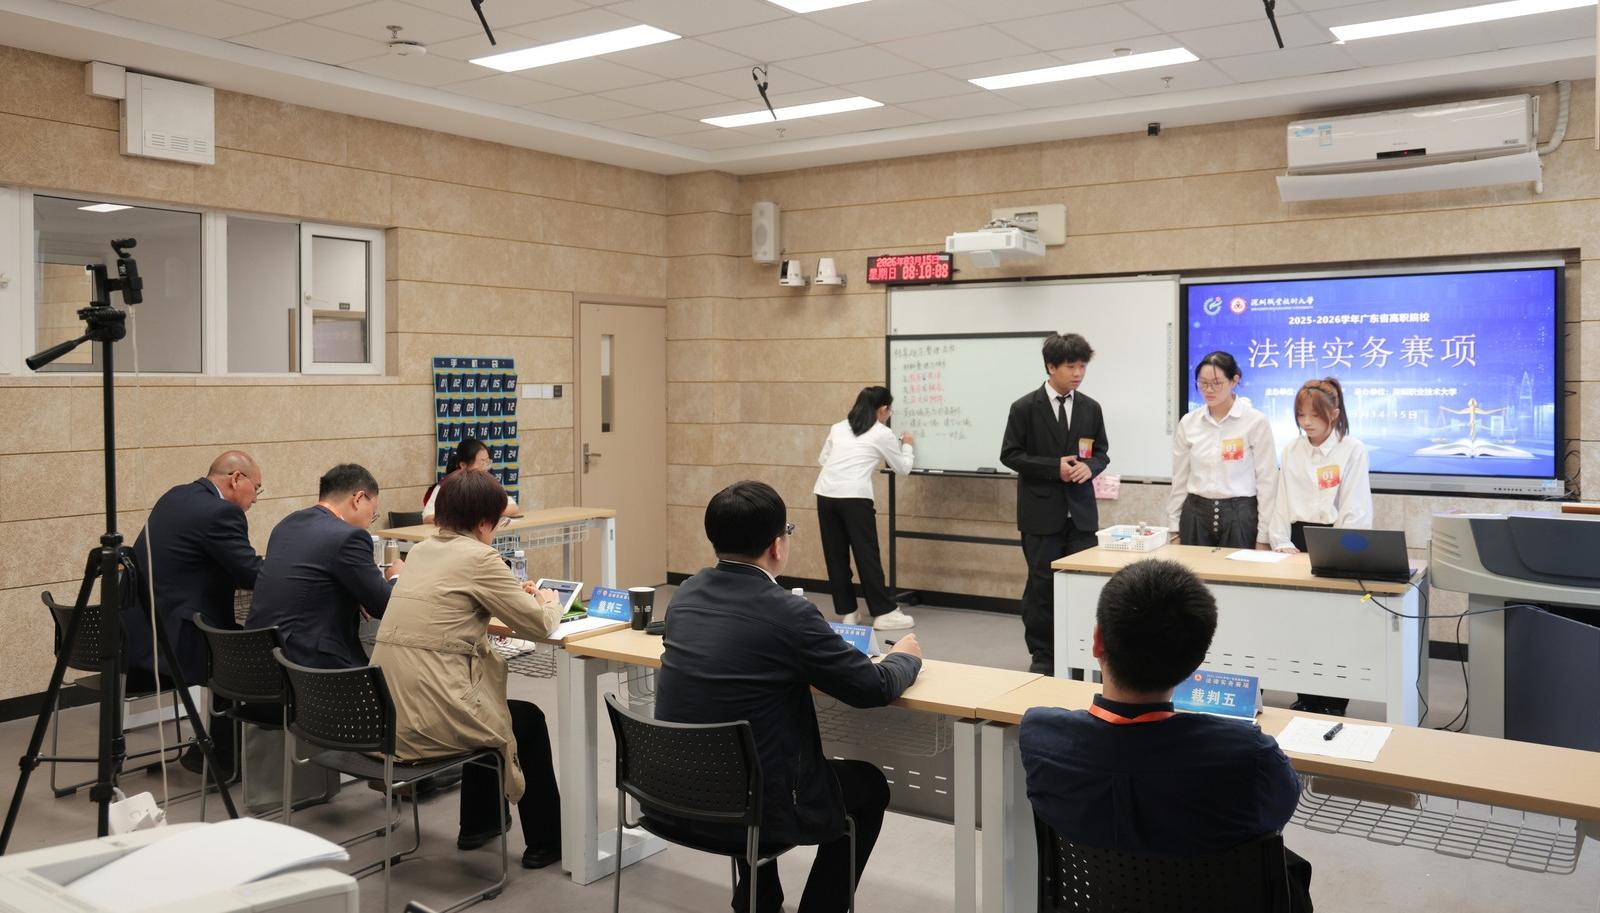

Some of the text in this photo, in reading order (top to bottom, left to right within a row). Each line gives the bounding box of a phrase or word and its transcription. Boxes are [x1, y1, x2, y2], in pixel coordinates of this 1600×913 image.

[868, 263, 949, 280] 星期日 08:10:08
[1248, 334, 1478, 368] 法律实务赛项
[452, 378, 461, 388] 02
[466, 378, 475, 388] 03
[480, 379, 488, 388] 04
[492, 379, 501, 388] 05
[507, 380, 516, 389] 06
[440, 403, 448, 413] 07
[481, 402, 489, 412] 10
[494, 402, 501, 411] 11
[507, 402, 515, 411] 12
[467, 427, 475, 437] 15
[494, 427, 501, 436] 17
[493, 450, 502, 459] 23
[508, 450, 517, 459] 24
[1192, 688, 1236, 706] 裁判五
